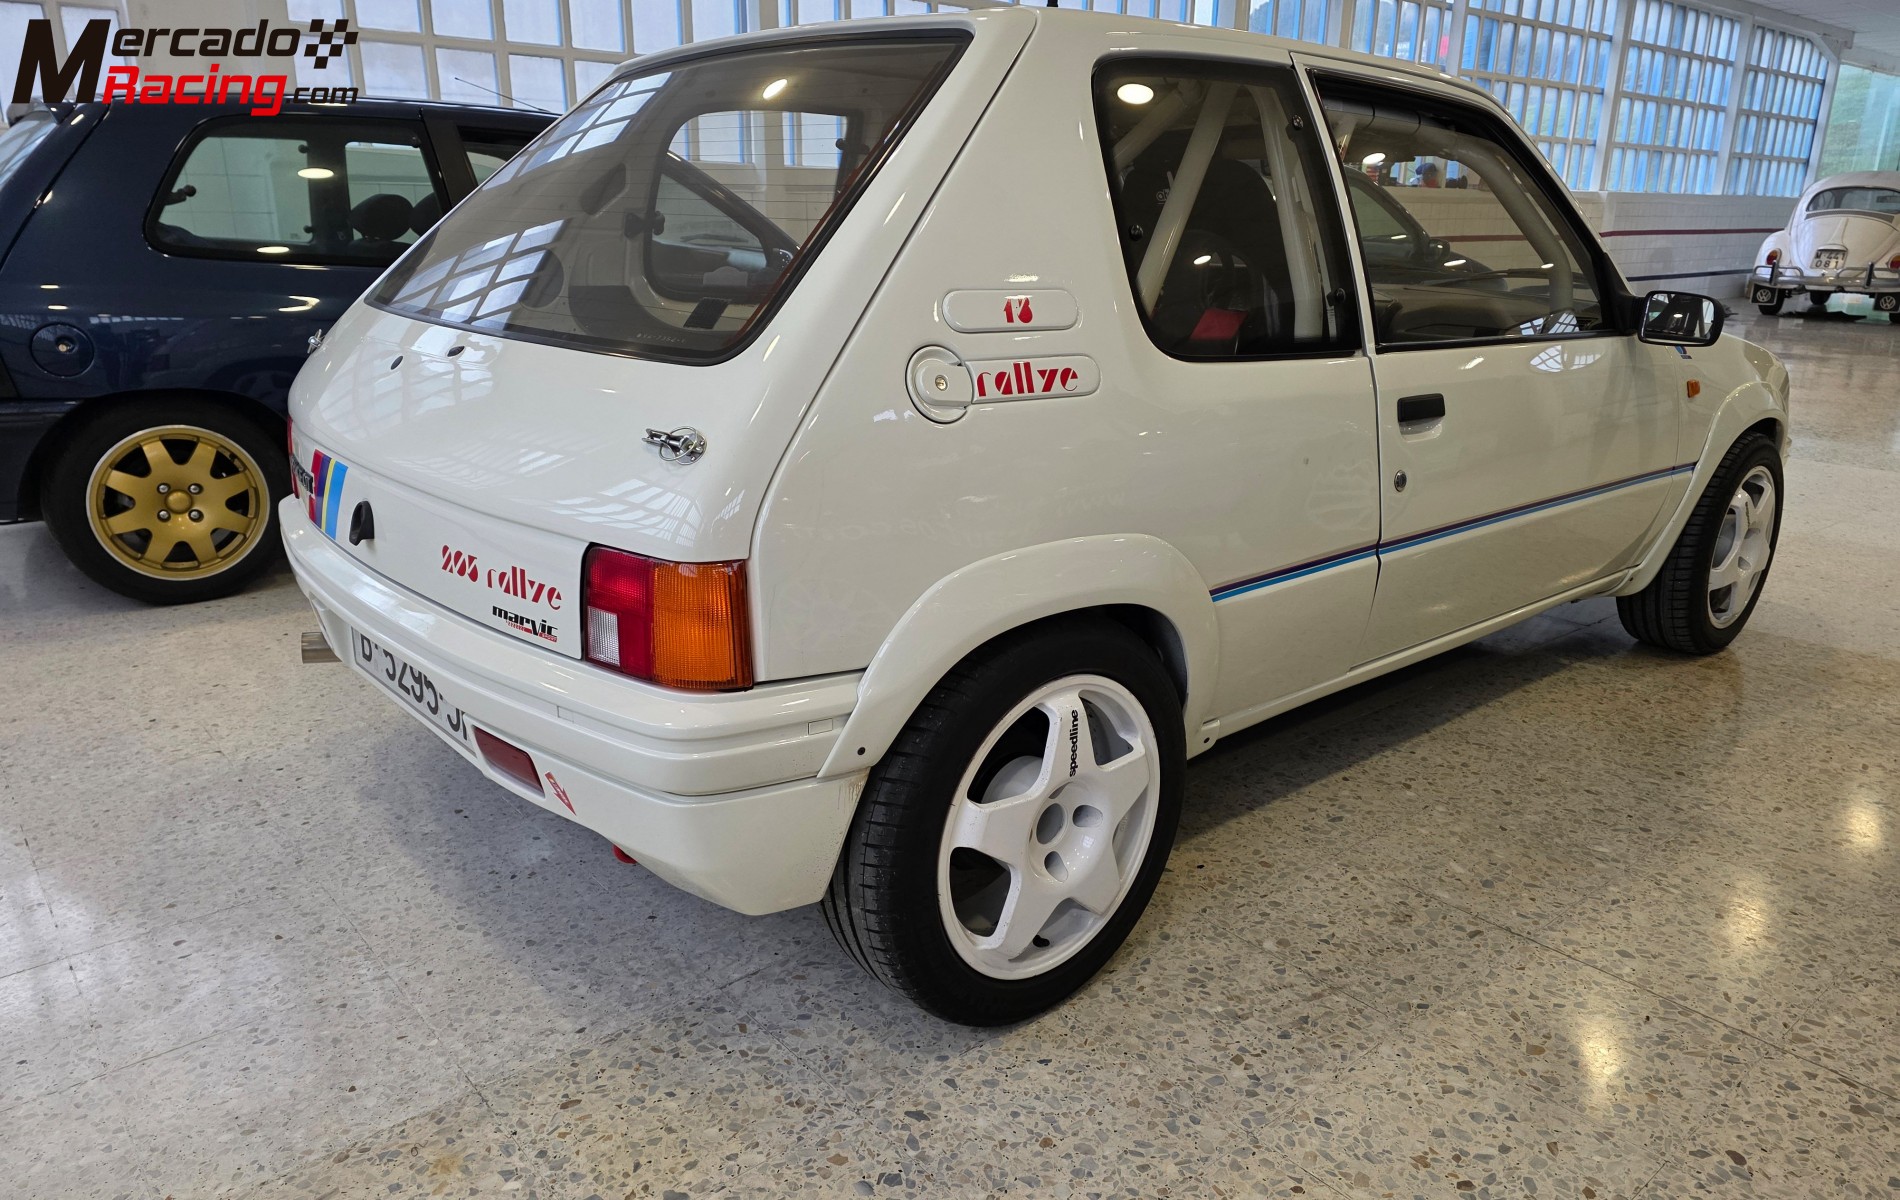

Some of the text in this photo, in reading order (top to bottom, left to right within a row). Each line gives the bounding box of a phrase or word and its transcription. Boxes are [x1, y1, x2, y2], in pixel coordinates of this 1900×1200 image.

[976, 361, 1079, 397] rallye
[487, 565, 562, 611] rallye
[492, 605, 559, 637] marvic
[1069, 709, 1079, 777] speedline
